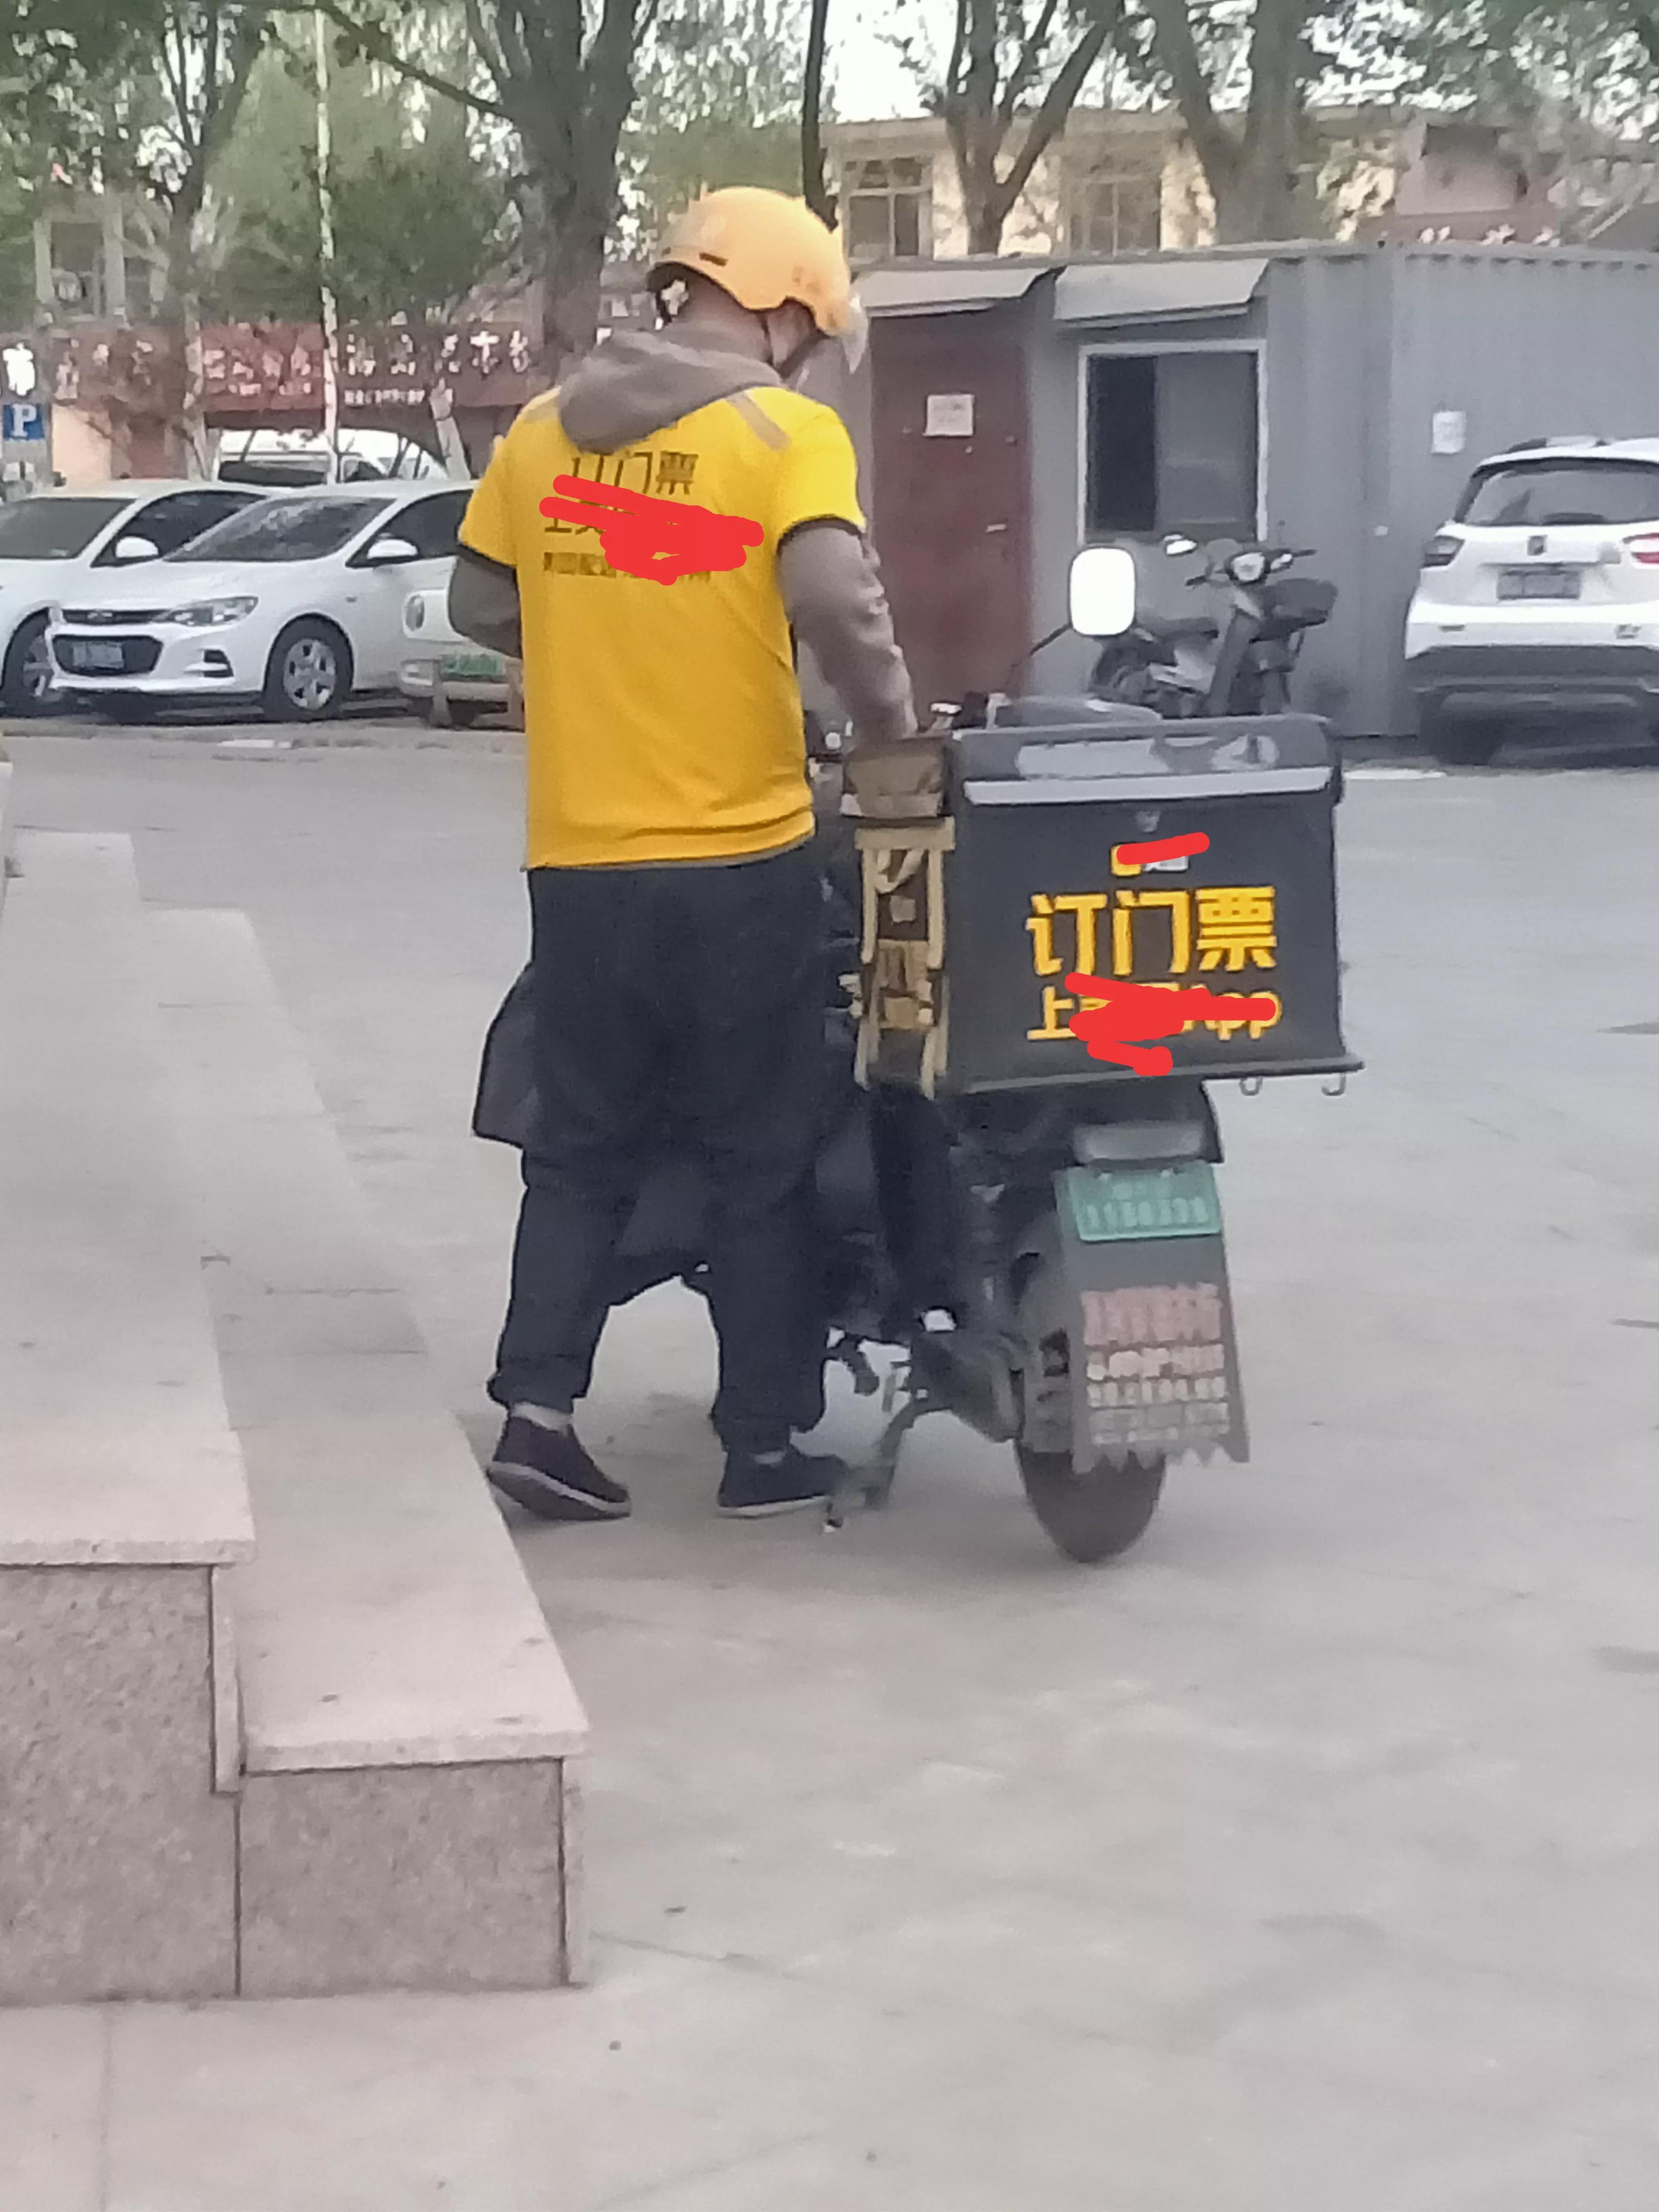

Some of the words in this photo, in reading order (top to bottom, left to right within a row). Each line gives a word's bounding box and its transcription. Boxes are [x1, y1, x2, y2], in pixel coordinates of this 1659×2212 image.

[11, 403, 37, 437] P
[1026, 886, 1277, 976] 订门票
